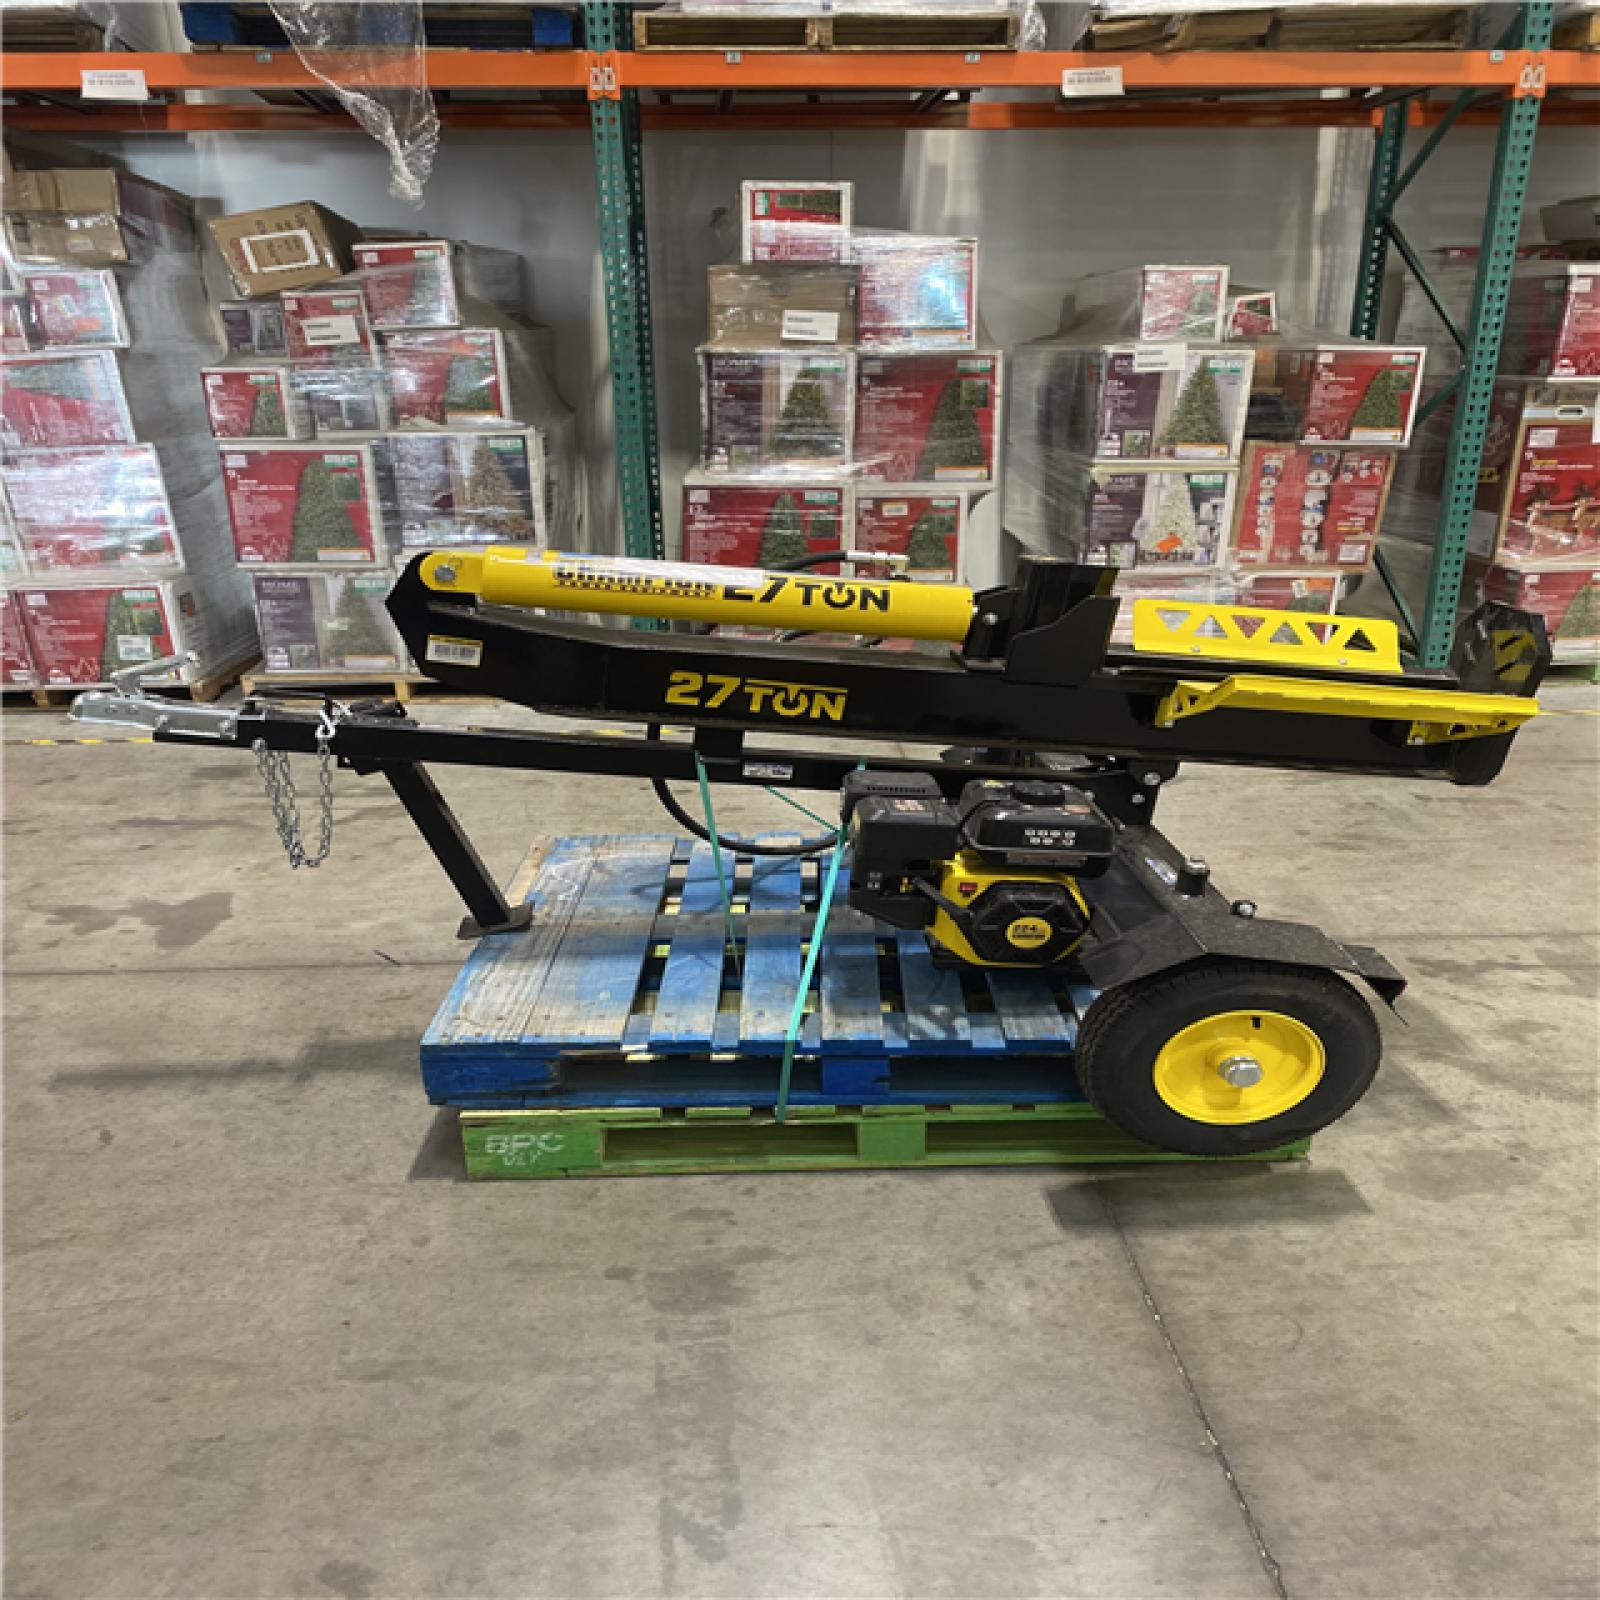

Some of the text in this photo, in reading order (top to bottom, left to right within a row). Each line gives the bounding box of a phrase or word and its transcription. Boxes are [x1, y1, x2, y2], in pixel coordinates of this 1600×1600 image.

[795, 581, 889, 612] TON
[665, 669, 848, 720] 27 TON
